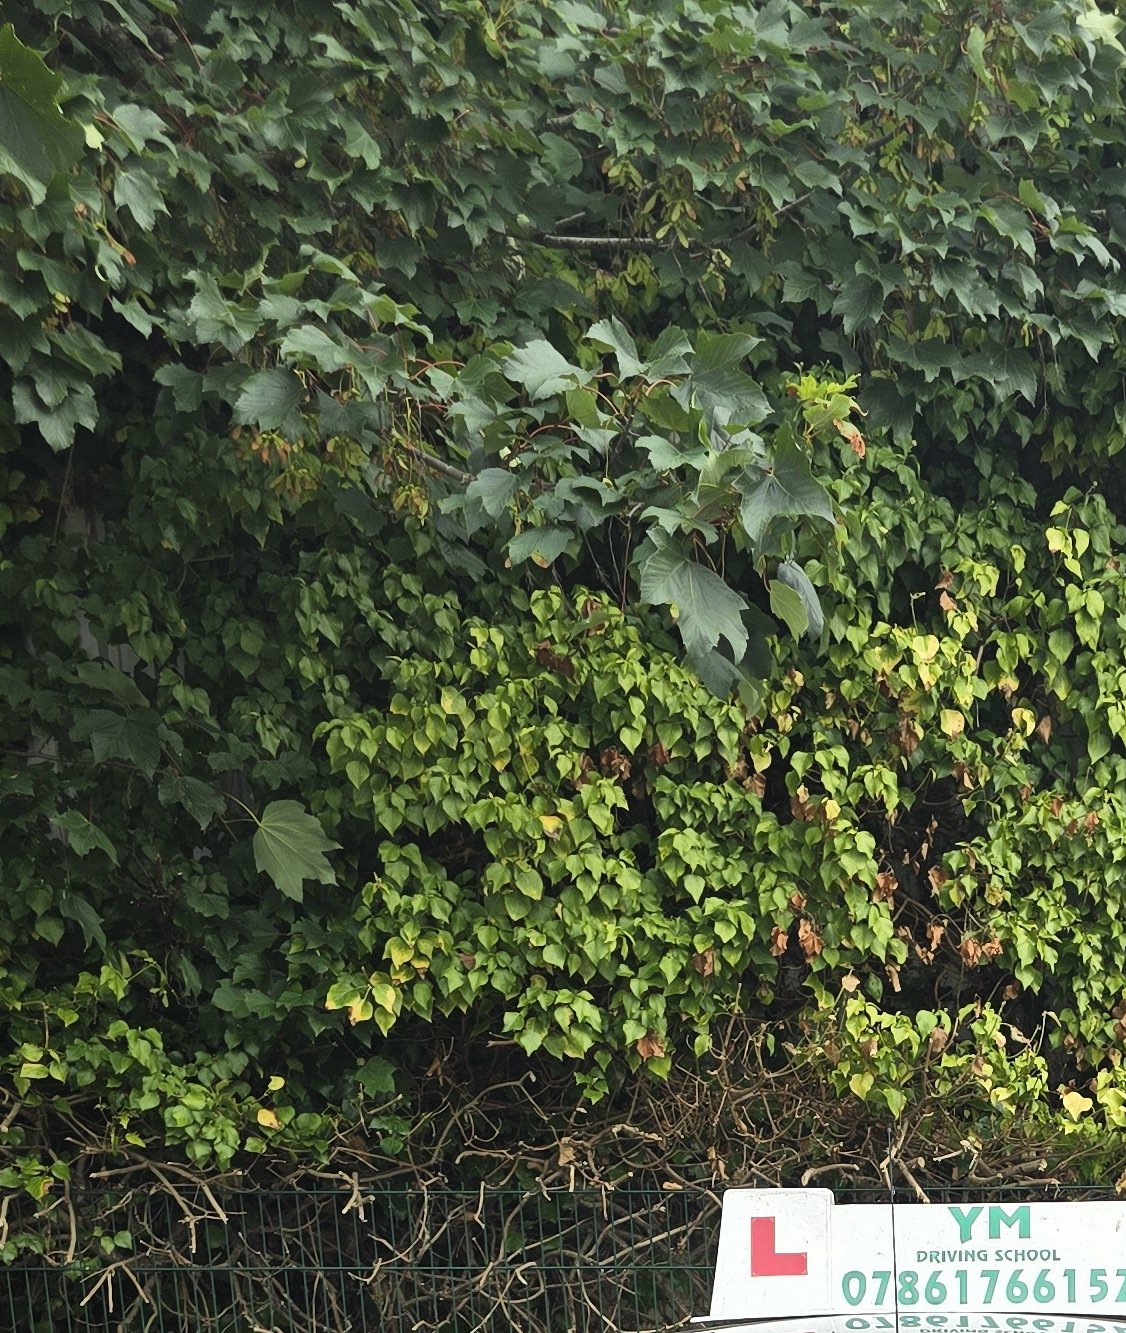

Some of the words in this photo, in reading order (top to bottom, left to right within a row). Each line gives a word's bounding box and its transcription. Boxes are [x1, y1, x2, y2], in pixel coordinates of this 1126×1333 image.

[947, 1205, 1031, 1244] YM
[751, 1216, 808, 1277] L
[916, 1249, 988, 1263] DRIVING
[994, 1249, 1061, 1262] SCHOOL
